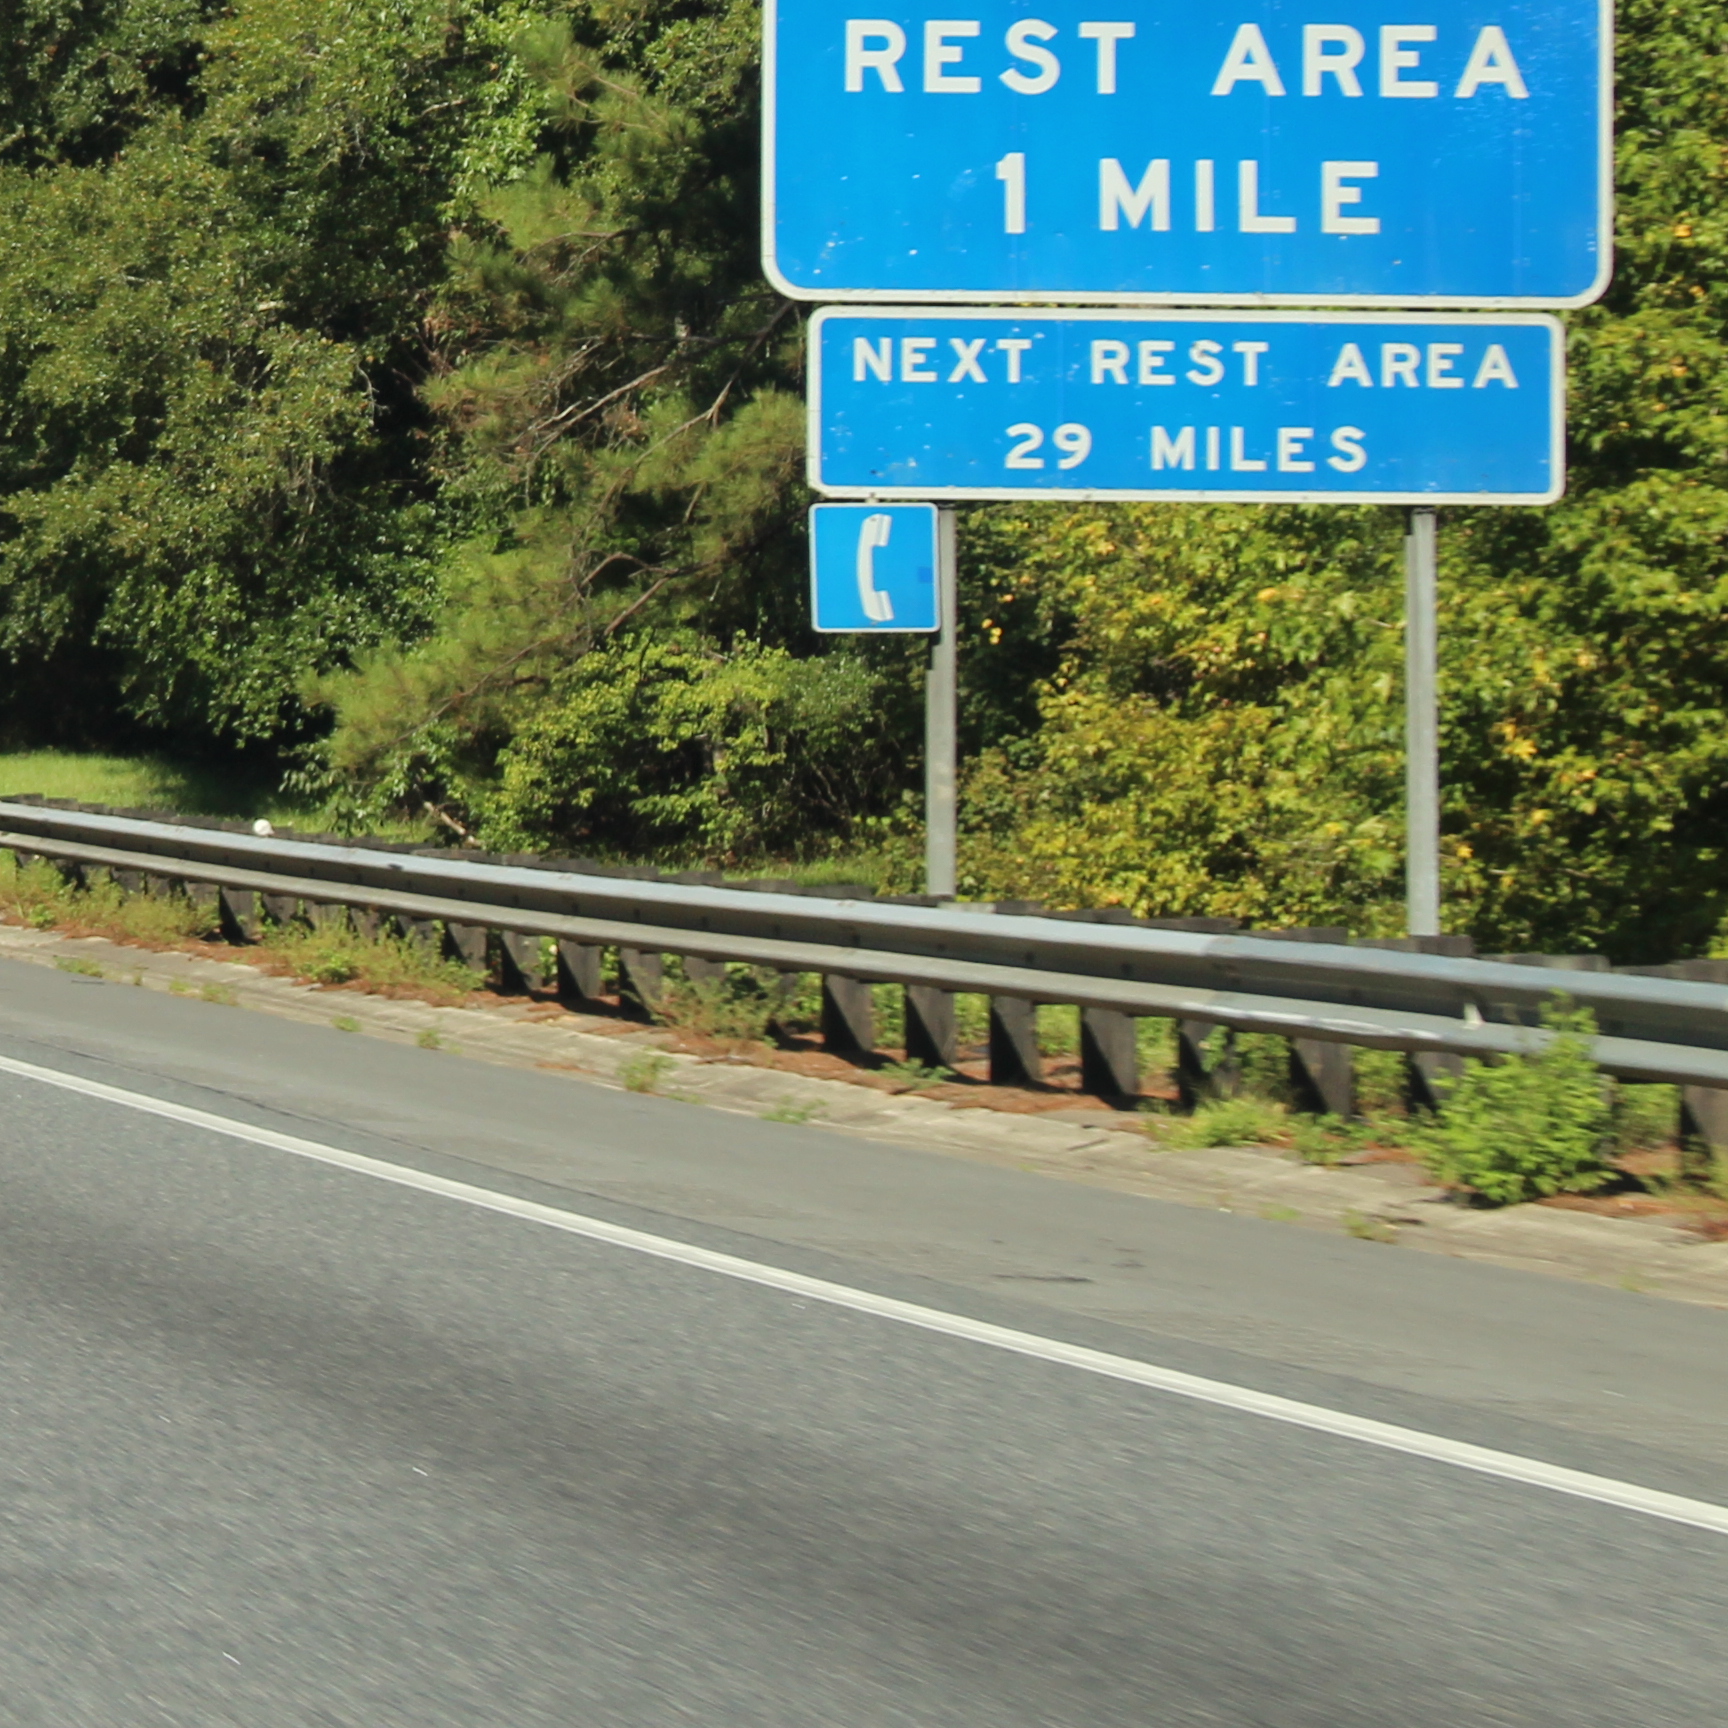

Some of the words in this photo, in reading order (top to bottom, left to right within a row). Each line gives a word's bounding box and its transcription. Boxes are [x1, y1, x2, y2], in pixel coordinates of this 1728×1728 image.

[843, 18, 1136, 96] REST
[1210, 22, 1531, 100] AREA
[995, 151, 1027, 235] 1
[1098, 157, 1381, 236] MILE
[852, 336, 1033, 385] NEXT
[1090, 338, 1270, 388] REST
[1327, 341, 1520, 390] AREA
[1004, 421, 1093, 471] 29
[1150, 424, 1368, 474] MILES
